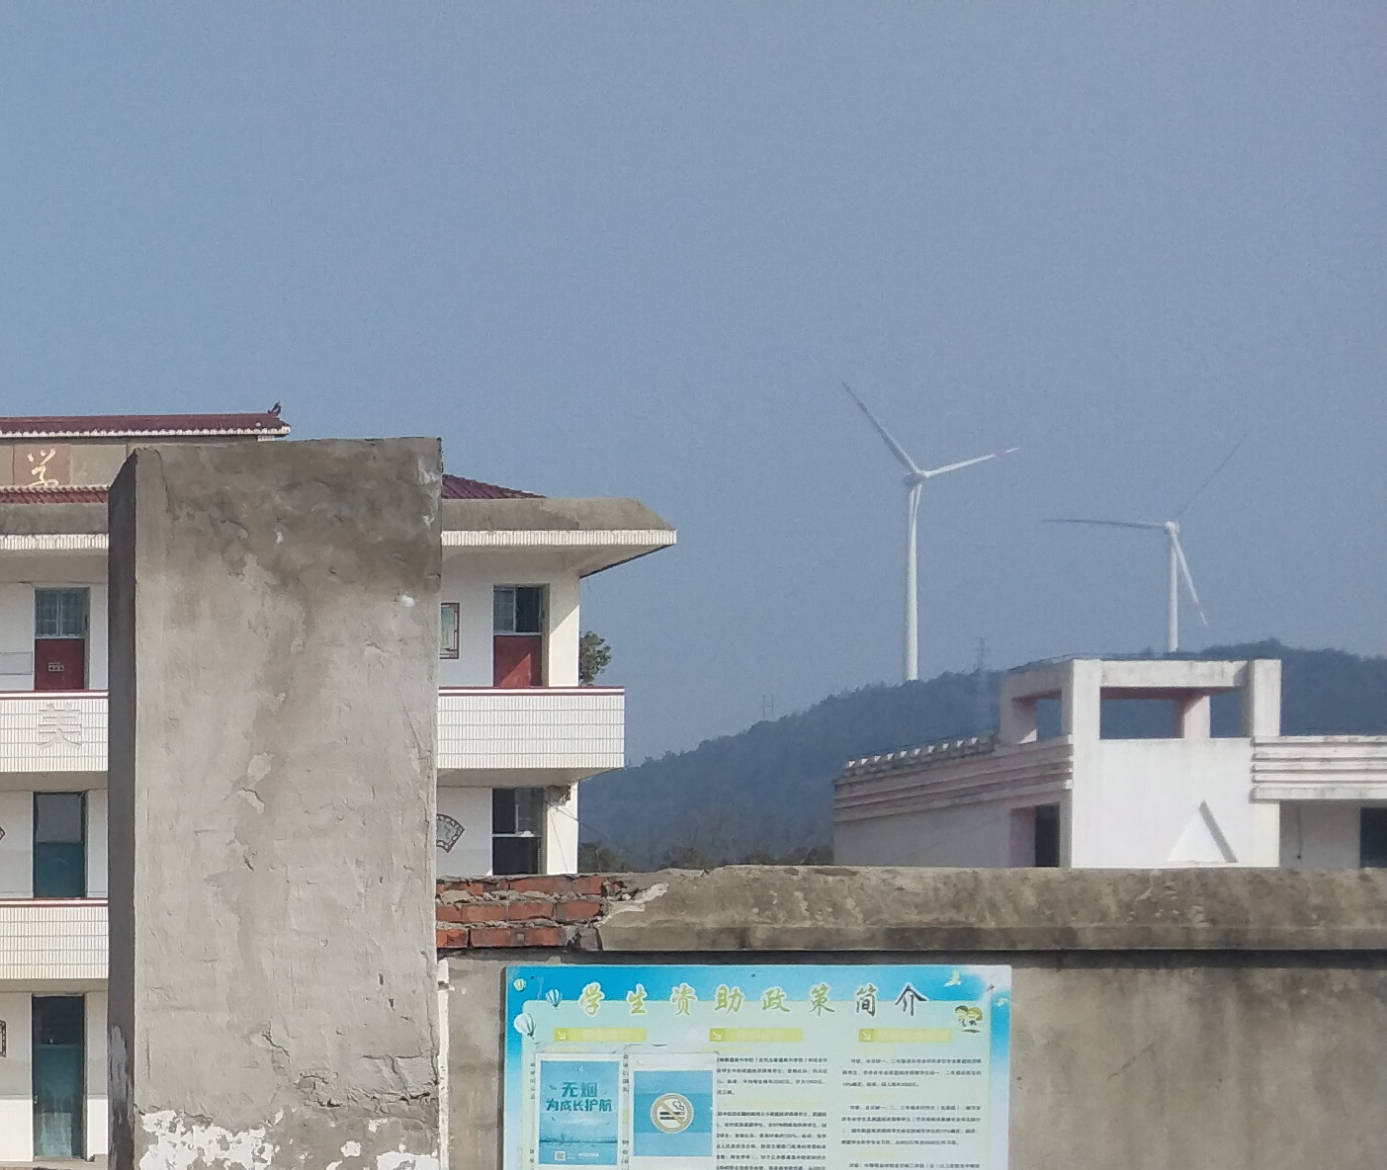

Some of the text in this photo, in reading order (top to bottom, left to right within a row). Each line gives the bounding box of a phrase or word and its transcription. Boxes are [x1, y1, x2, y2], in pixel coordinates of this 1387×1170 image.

[578, 981, 929, 1019] 学生资助政策简介
[560, 1081, 598, 1098] 无烟
[546, 1098, 612, 1112] 为成长护航
